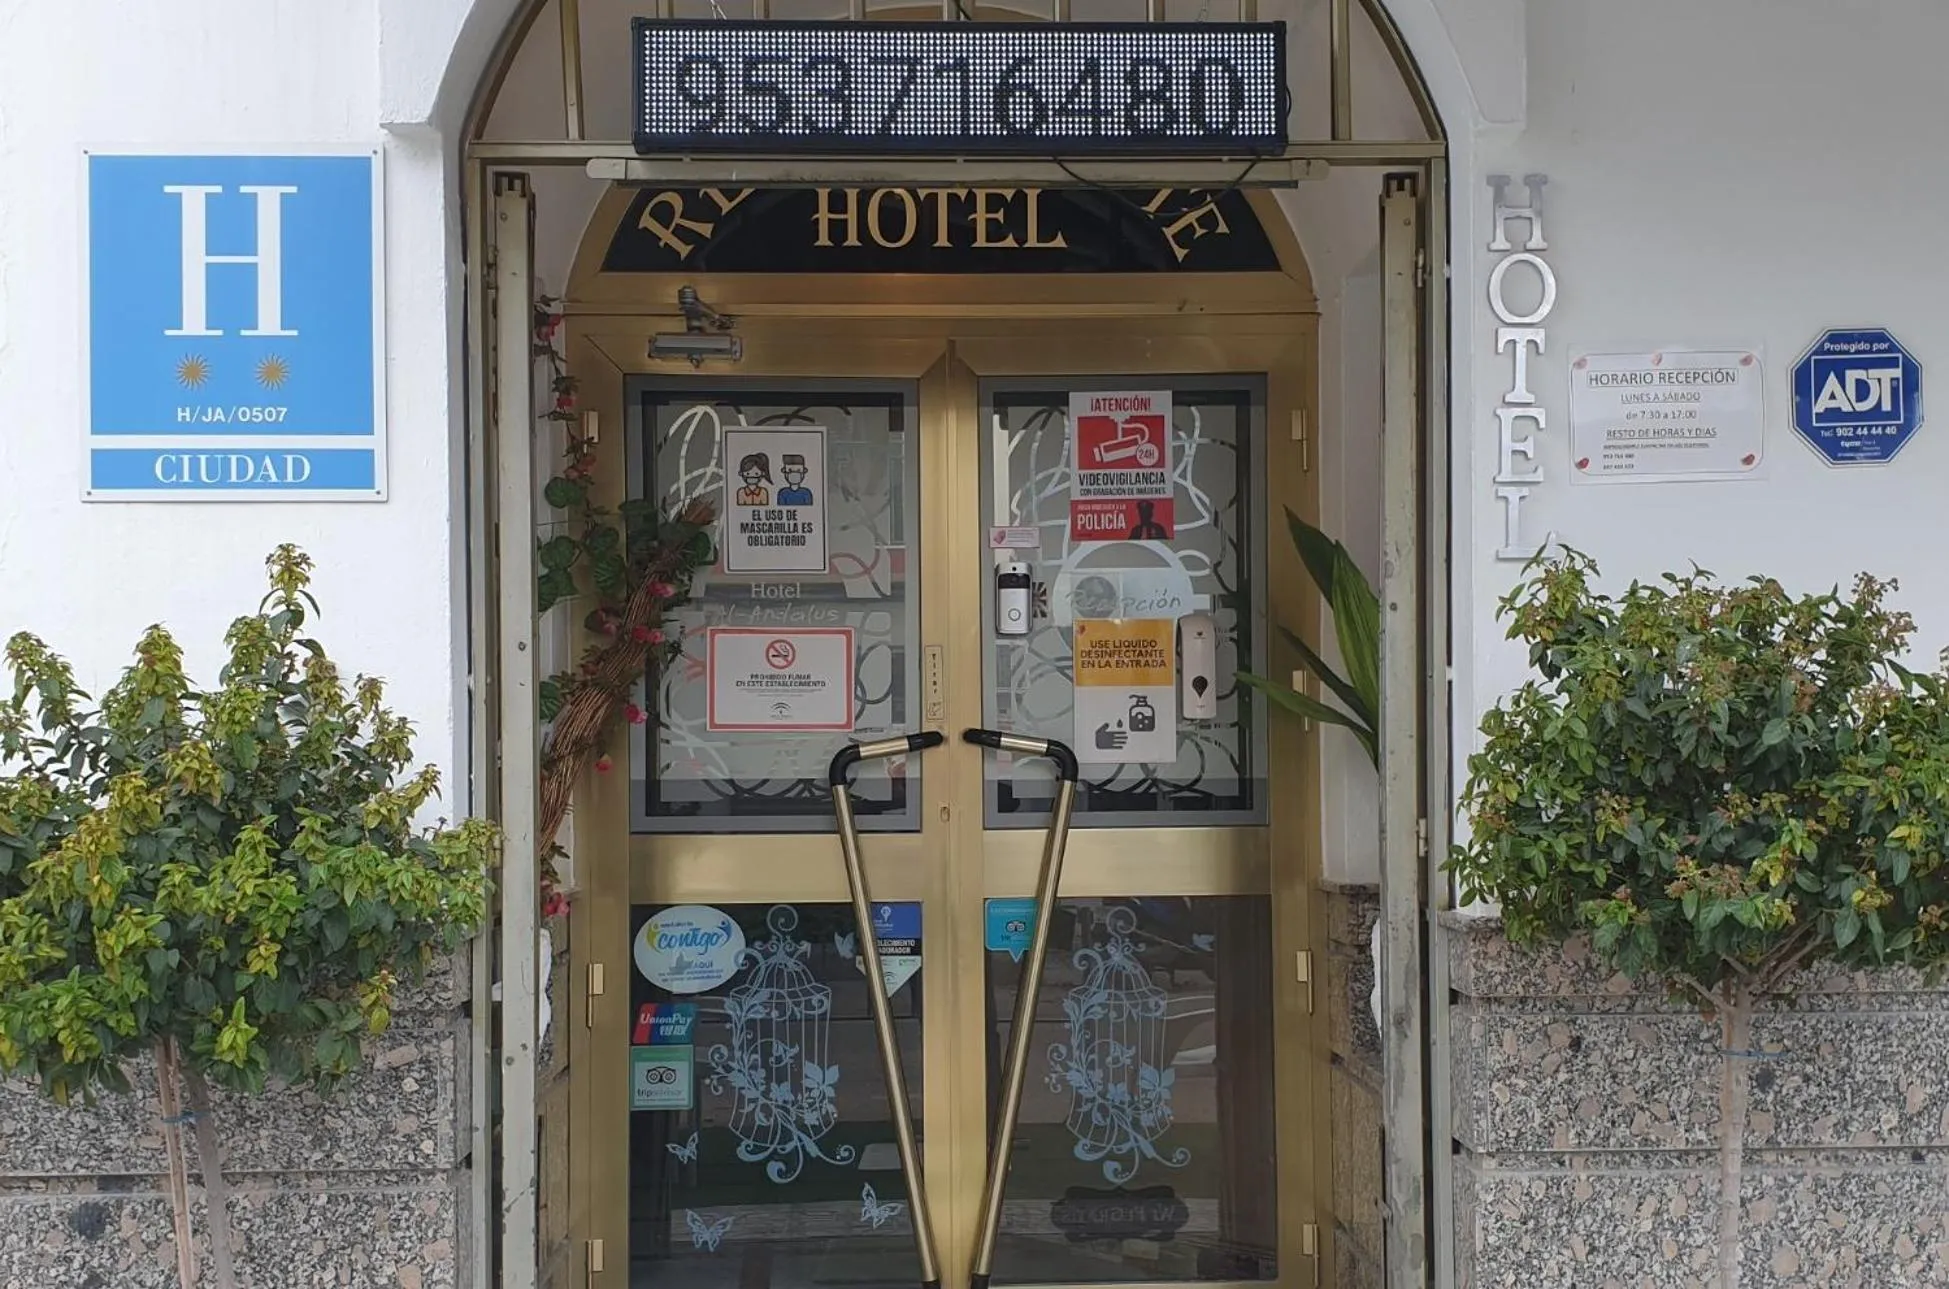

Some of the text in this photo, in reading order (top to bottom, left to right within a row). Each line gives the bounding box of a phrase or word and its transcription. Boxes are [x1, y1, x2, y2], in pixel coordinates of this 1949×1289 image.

[811, 187, 1067, 248] HOTEL
[164, 185, 298, 336] H
[1823, 342, 1889, 352] Protegido por
[1486, 174, 1556, 560] HOTEL
[1589, 368, 1736, 385] HORARIO RECEPCIÓN
[1814, 368, 1901, 412] ADT
[1621, 393, 1650, 402] LUNES
[1653, 393, 1660, 401] A
[177, 406, 287, 423] H/JA/0507
[1607, 429, 1635, 438] RESTO
[1638, 428, 1650, 437] DE
[1835, 427, 1854, 437] 902
[1856, 427, 1868, 436] 44
[1870, 426, 1883, 435] 44
[1885, 426, 1897, 435] 40
[155, 454, 311, 484] CIUDAD
[1079, 471, 1166, 486] VIDEOVIGILANCIA
[752, 510, 797, 521] EL USO DE
[1077, 511, 1126, 530] POLICÍA
[740, 522, 813, 534] MASCARILLA ES
[747, 535, 806, 546] OBLIGATORIO
[751, 582, 800, 599] Hotel
[1090, 639, 1110, 648] USE
[1080, 650, 1164, 659] DESINFECTANTE
[1081, 659, 1167, 669] EN LA ENTRADA
[658, 927, 721, 955] contigo
[640, 1012, 693, 1026] UnionPay
